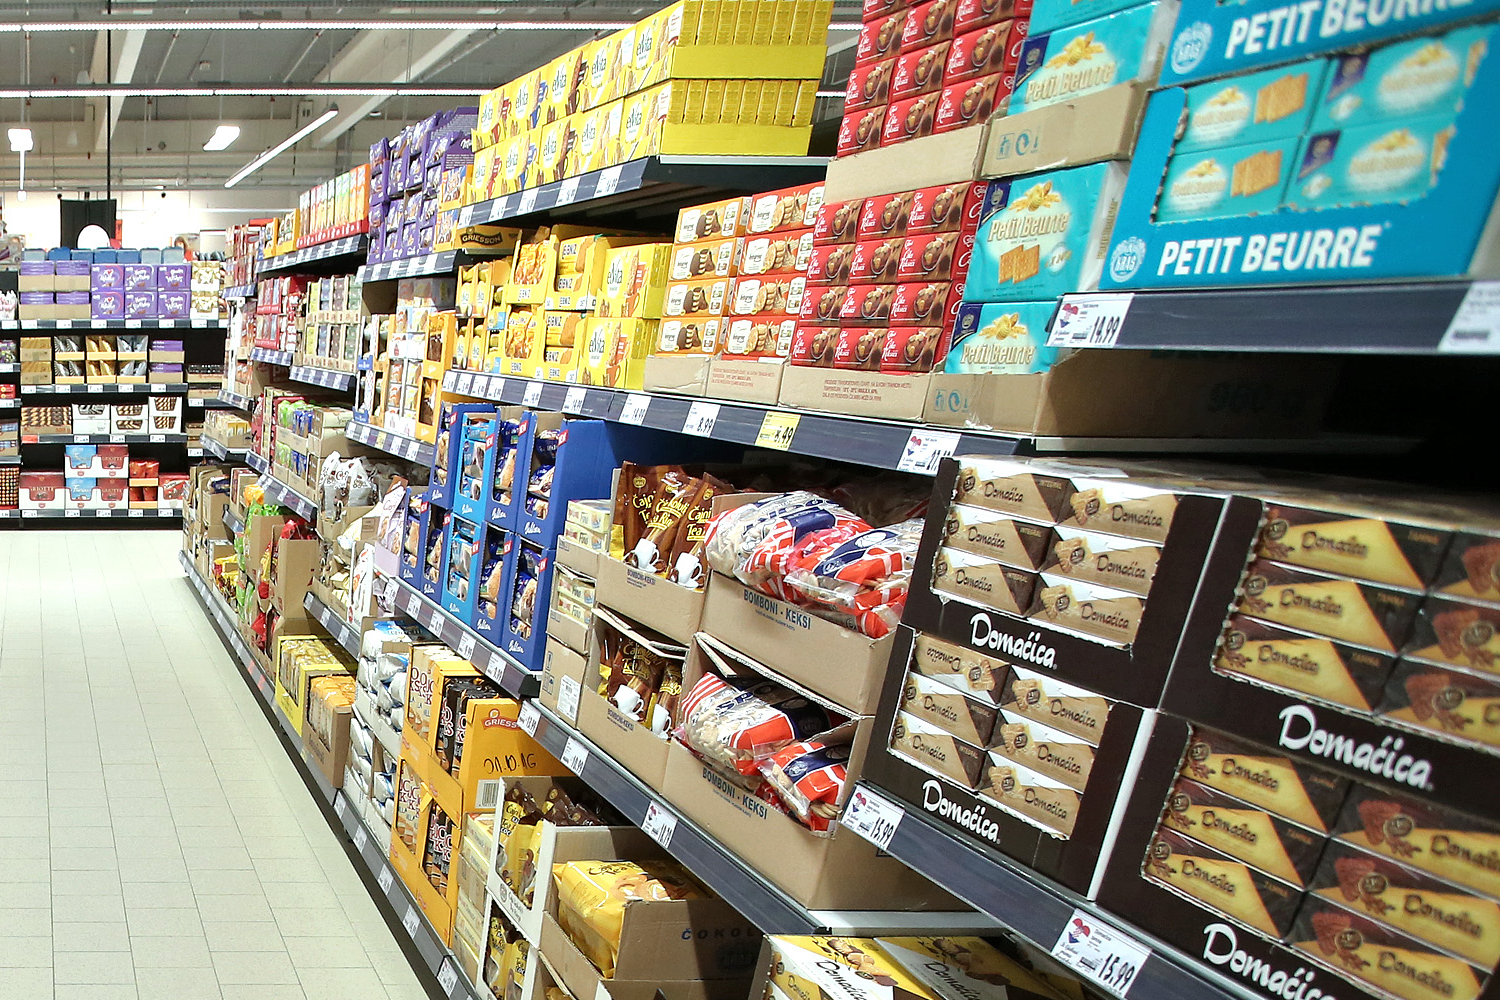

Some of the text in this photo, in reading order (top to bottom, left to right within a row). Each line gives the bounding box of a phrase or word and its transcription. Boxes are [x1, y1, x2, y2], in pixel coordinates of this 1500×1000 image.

[1225, 4, 1322, 59] PETIT
[987, 212, 1071, 242] Petit Beurre
[1156, 225, 1381, 276] PETIT BEURRE
[960, 340, 1035, 367] Petit Beurre
[1111, 503, 1164, 529] Domaćica
[1097, 553, 1146, 582] Domaćica
[743, 590, 812, 630] BOMBONI KEKSI
[970, 613, 1056, 669] Domaćica
[484, 719, 518, 728] GRIESS
[1278, 705, 1432, 790] Domaćica
[922, 779, 999, 844] Domaćica
[872, 820, 894, 845] 15.99
[1098, 953, 1135, 991] 15.99
